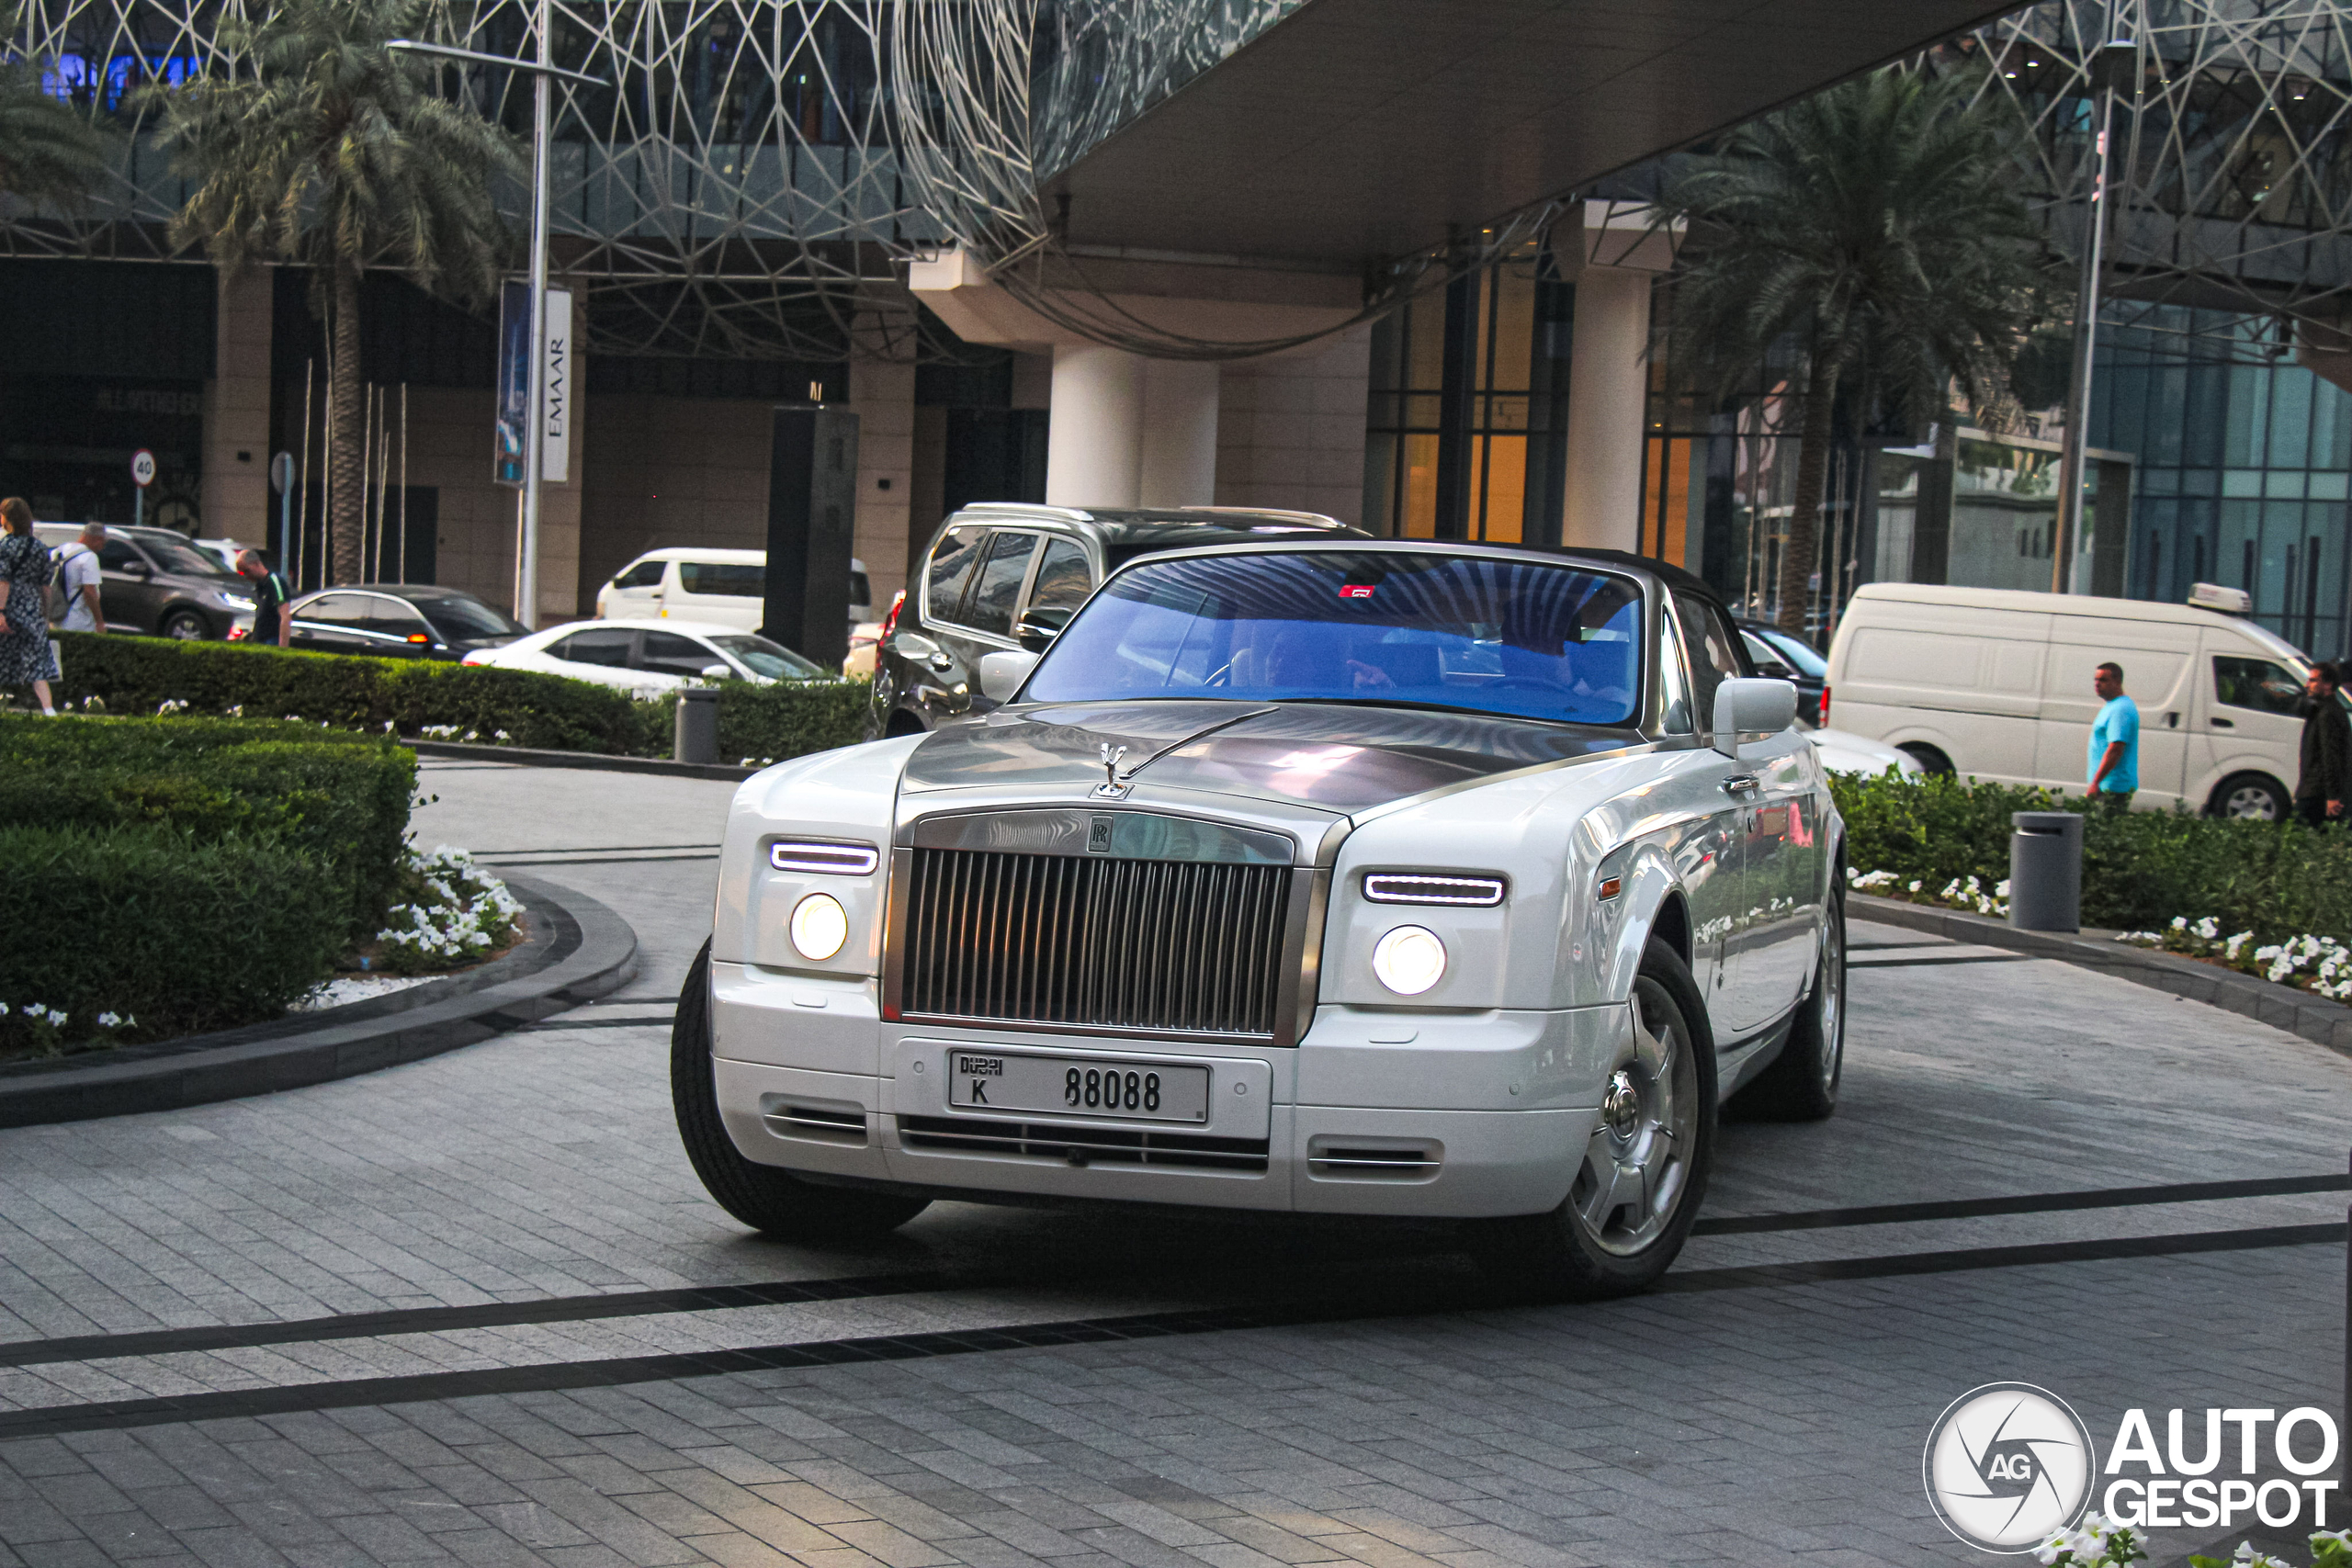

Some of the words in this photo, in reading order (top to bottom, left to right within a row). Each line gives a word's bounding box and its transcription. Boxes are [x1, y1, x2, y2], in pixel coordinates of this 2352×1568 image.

[548, 338, 564, 436] EMAAR
[137, 460, 153, 475] 40
[972, 1077, 989, 1104] K
[1065, 1066, 1160, 1111] 88088
